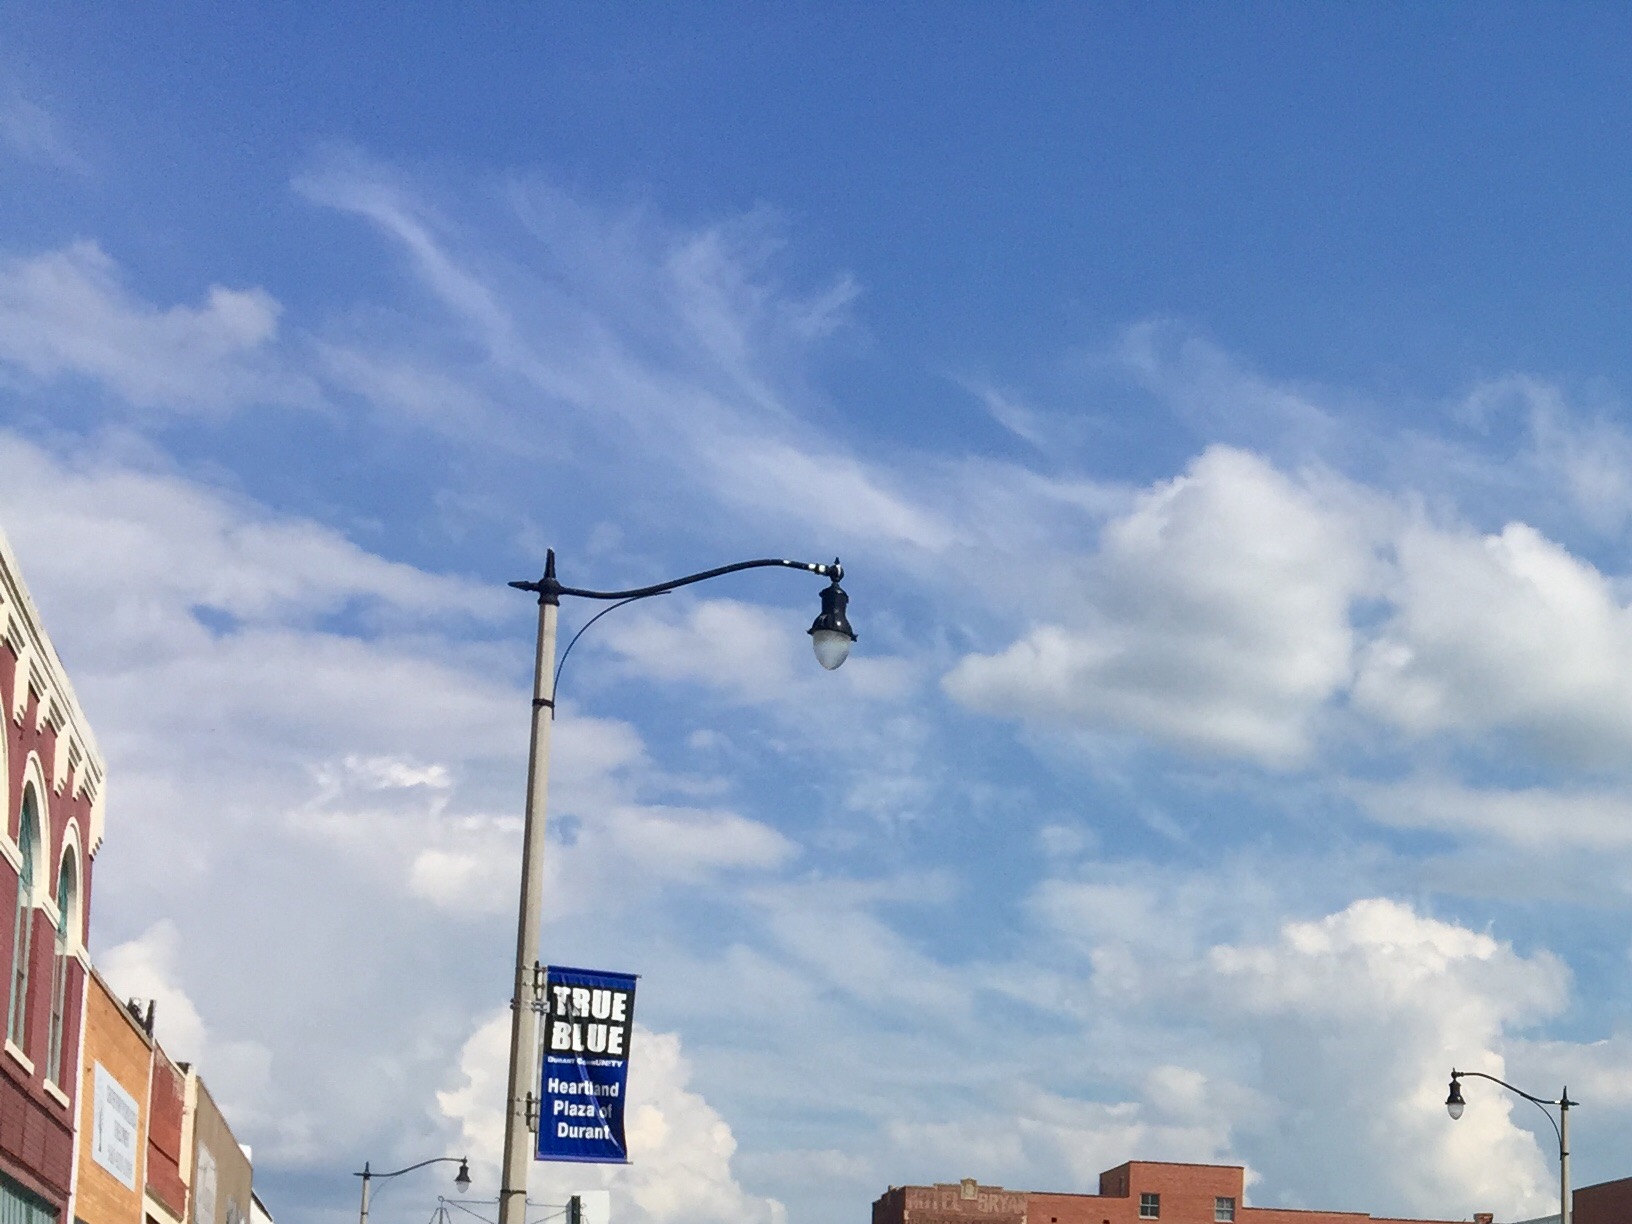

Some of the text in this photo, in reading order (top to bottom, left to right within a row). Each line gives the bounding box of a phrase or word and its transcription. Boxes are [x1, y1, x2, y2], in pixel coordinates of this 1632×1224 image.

[553, 986, 627, 1022] TRUE
[551, 1021, 624, 1055] BLUE
[548, 1077, 620, 1097] Heartland
[553, 1100, 613, 1119] Plaza of
[557, 1122, 611, 1140] Durant
[978, 1192, 1027, 1214] BRYAN
